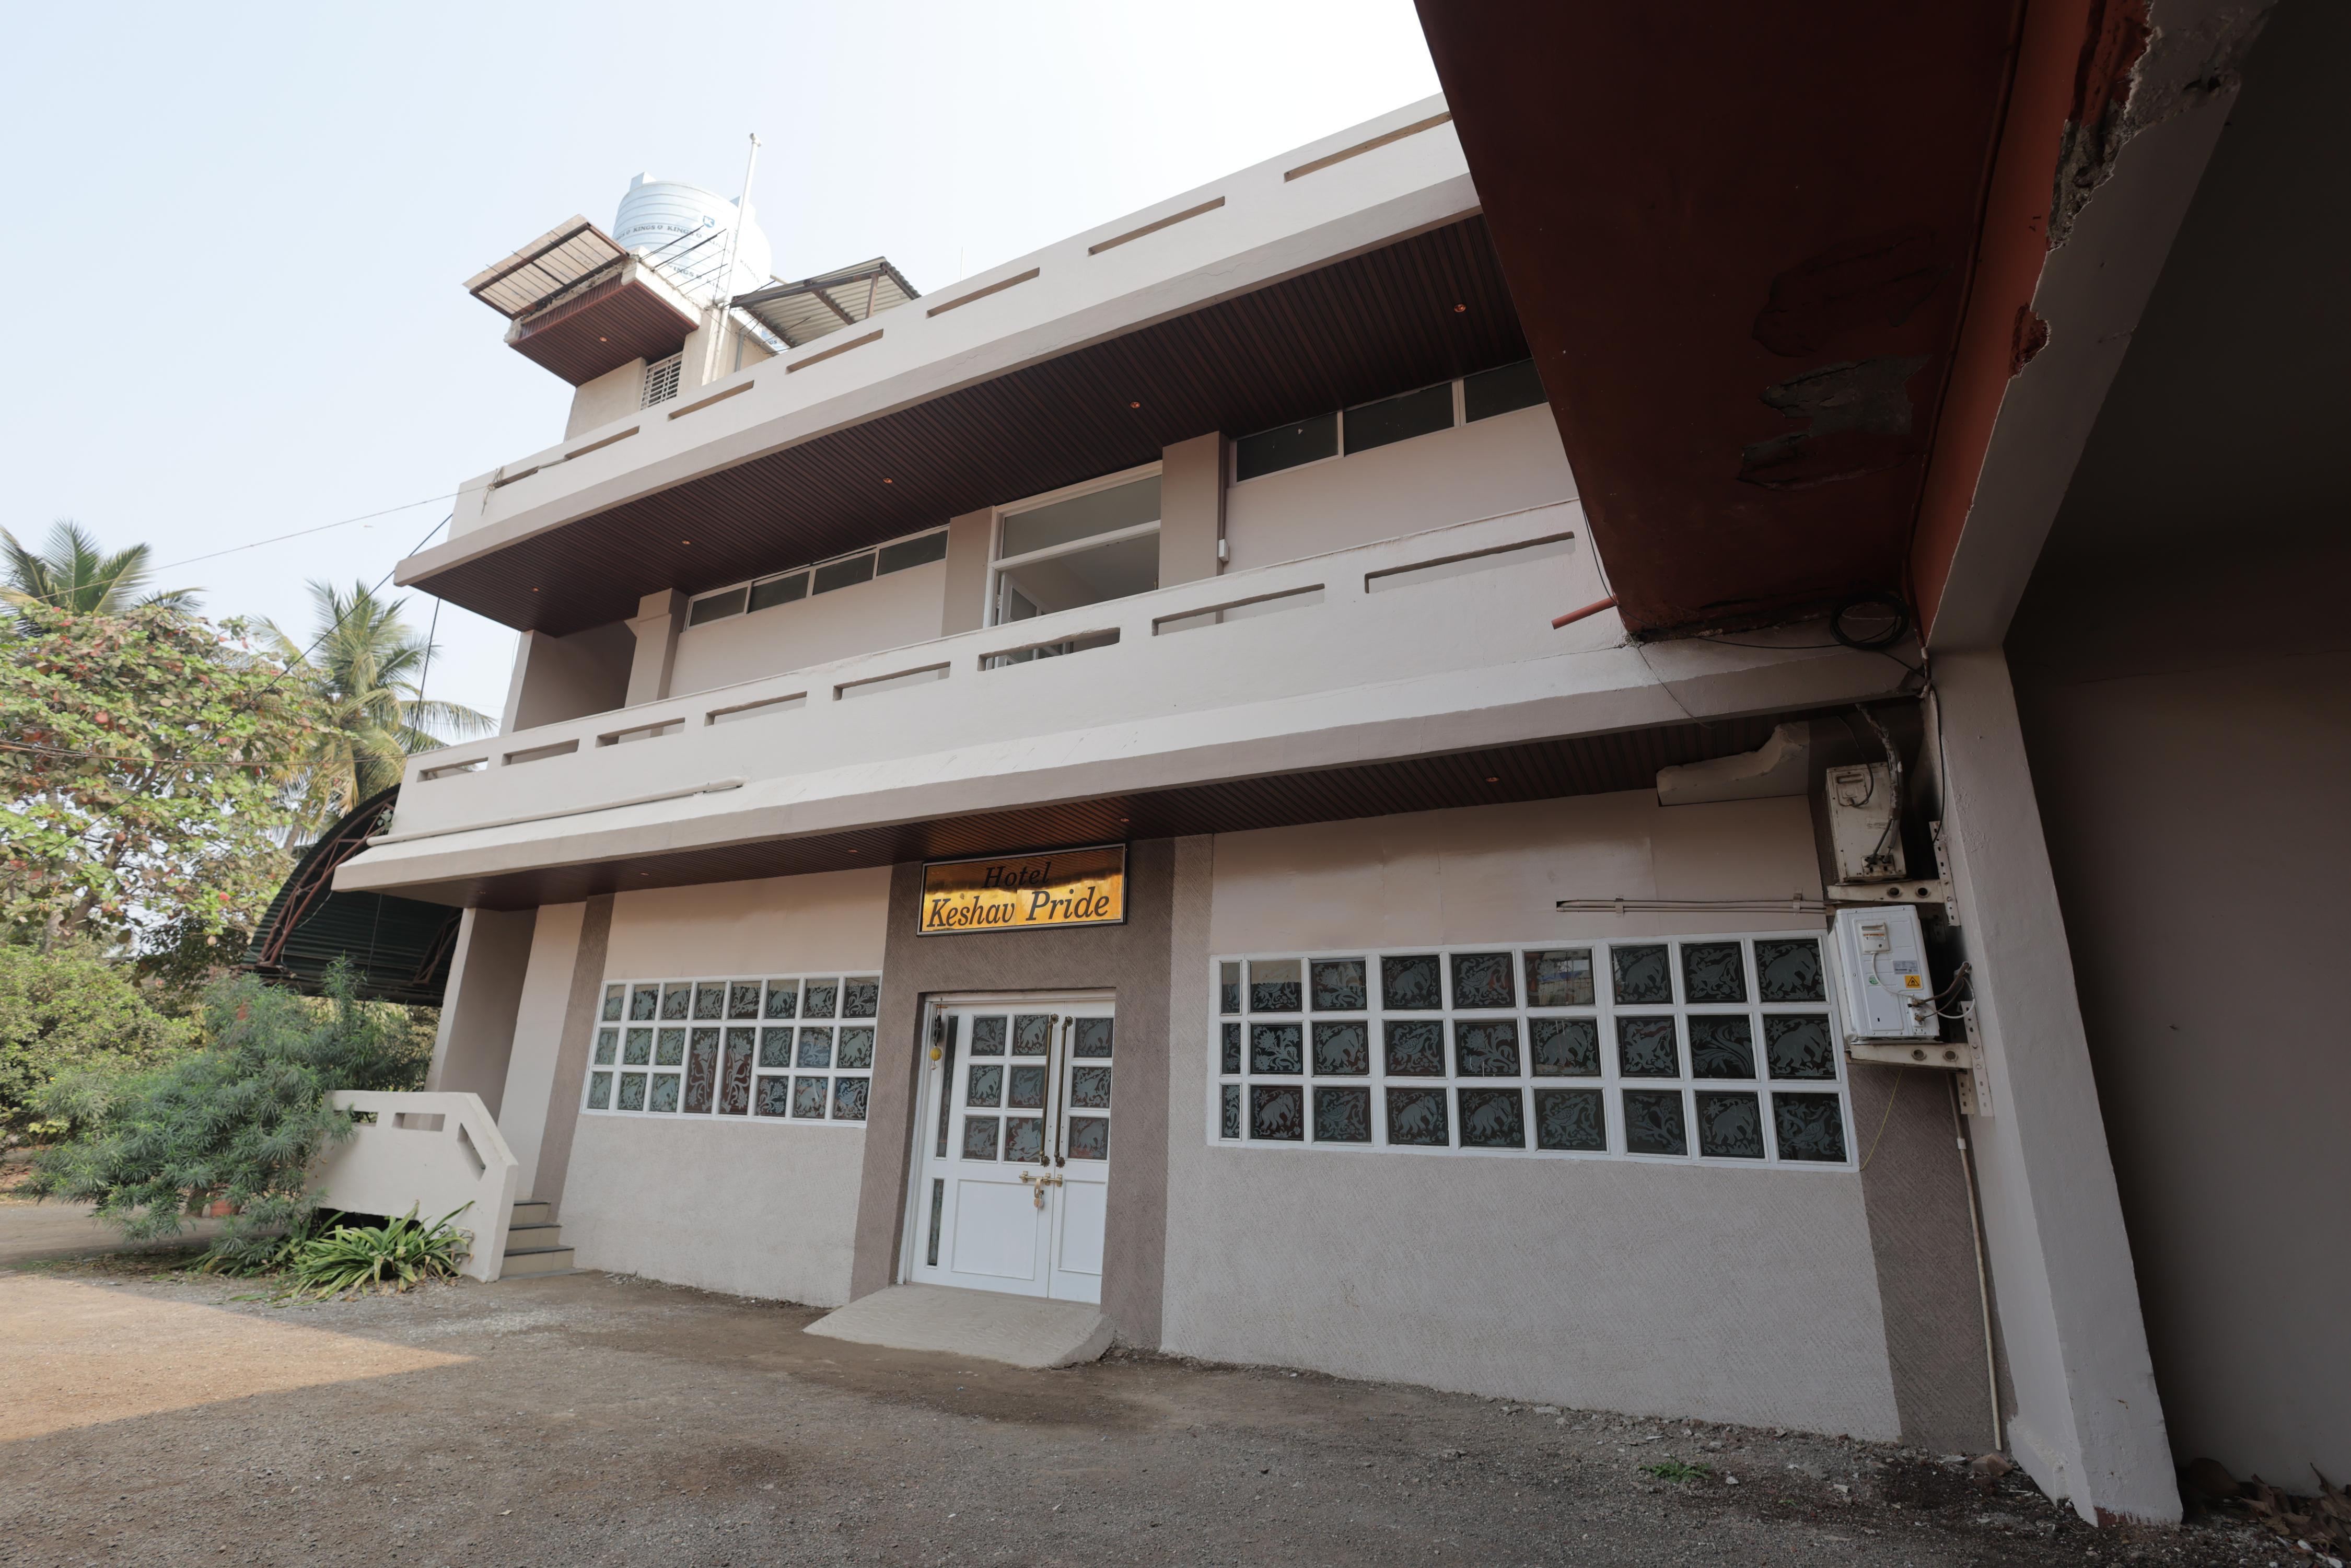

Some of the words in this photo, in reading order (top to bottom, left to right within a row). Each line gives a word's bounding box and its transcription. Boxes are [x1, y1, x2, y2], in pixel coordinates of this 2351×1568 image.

[667, 225, 694, 236] KINGS
[982, 862, 1052, 889] Hotel
[926, 896, 1016, 927] Keshav
[1026, 886, 1109, 921] Pride
